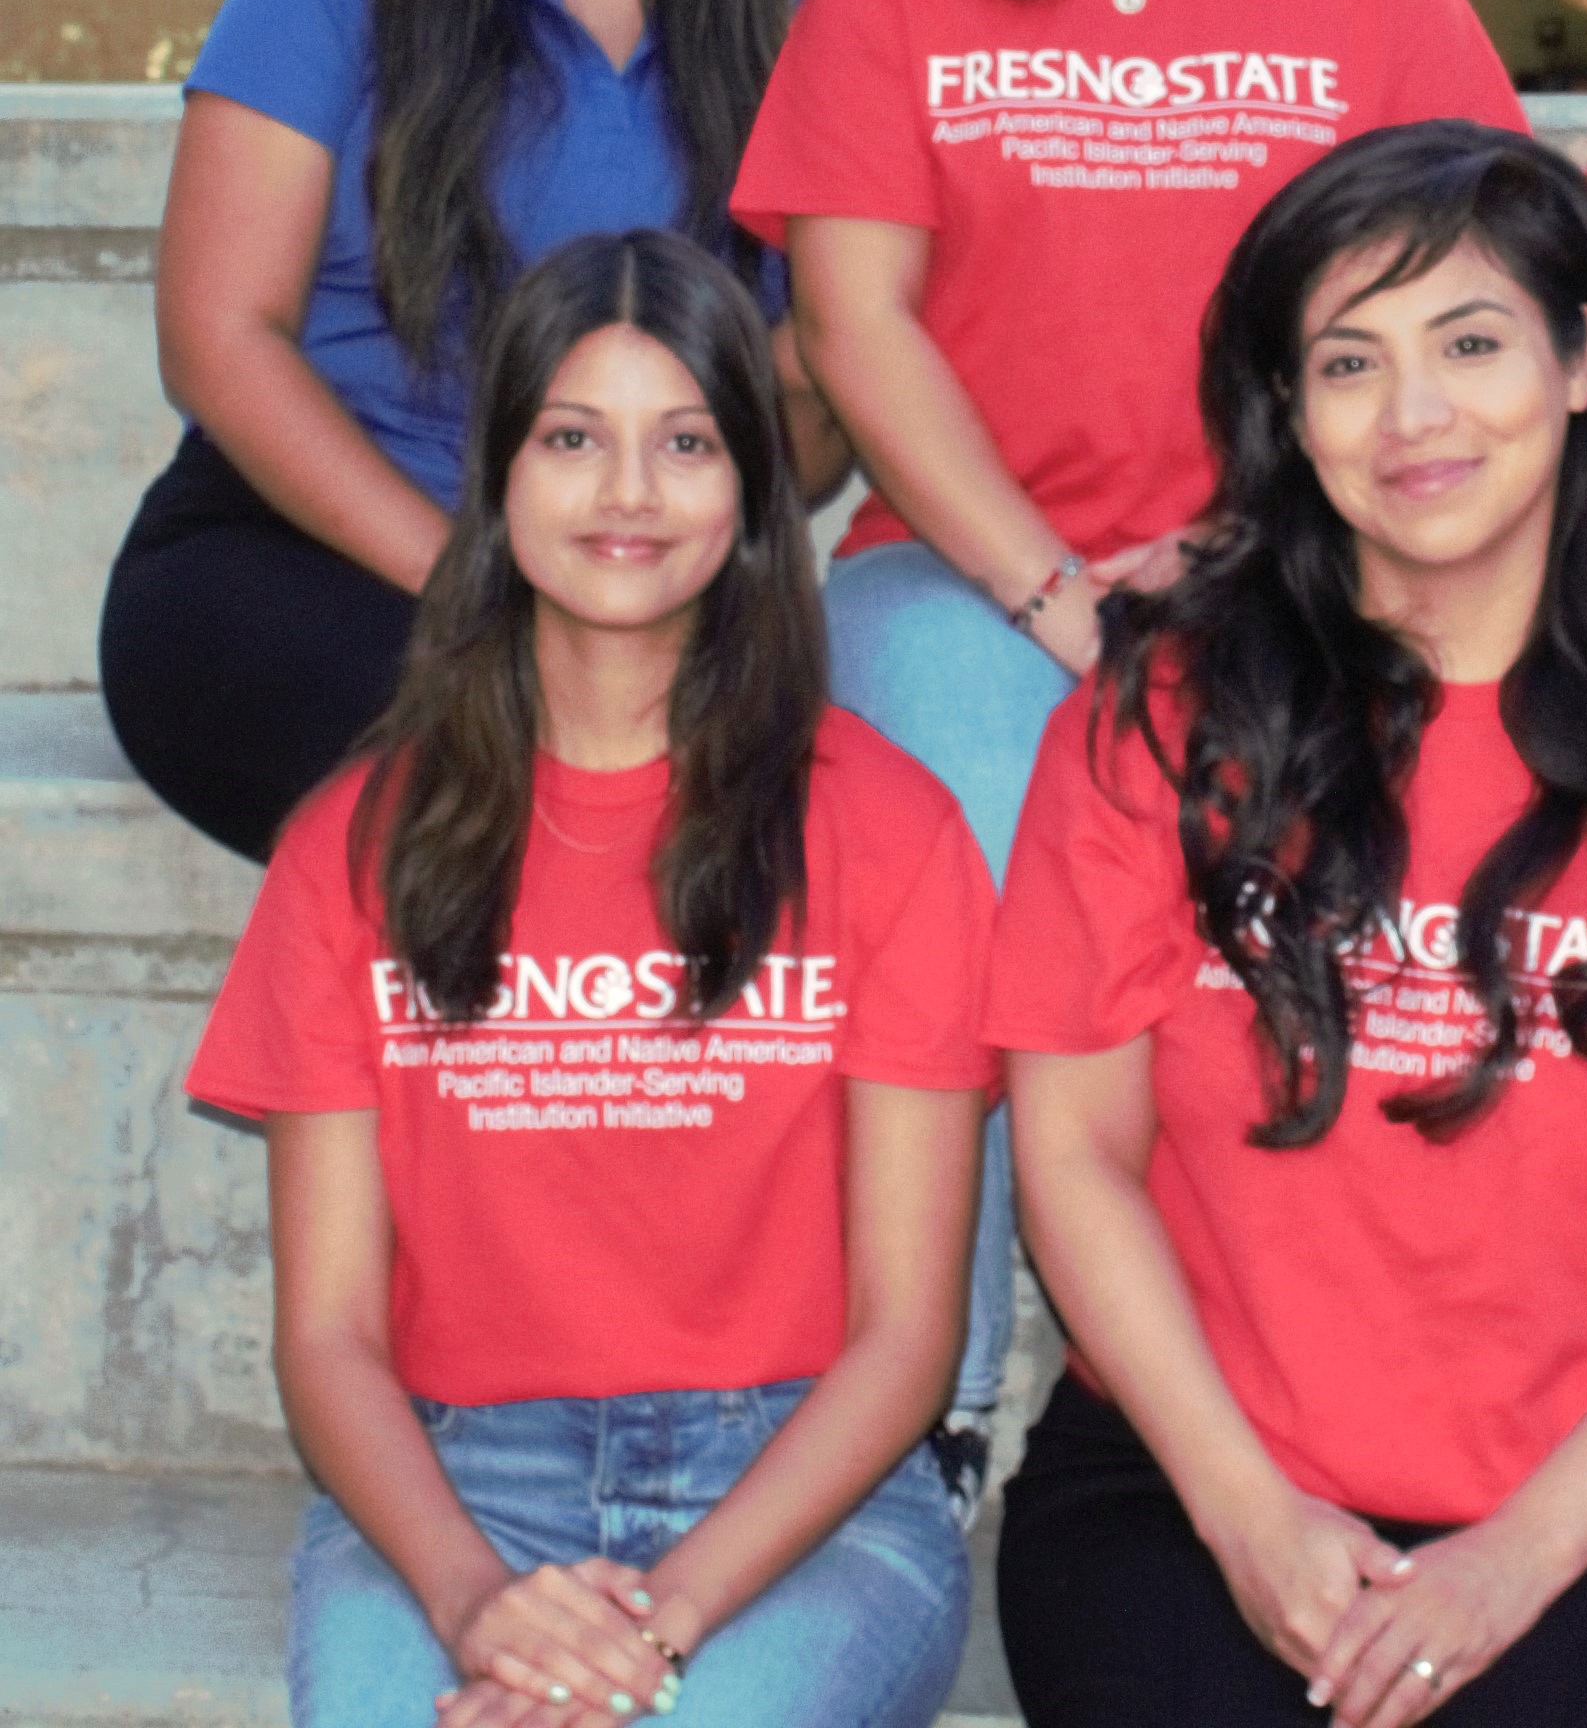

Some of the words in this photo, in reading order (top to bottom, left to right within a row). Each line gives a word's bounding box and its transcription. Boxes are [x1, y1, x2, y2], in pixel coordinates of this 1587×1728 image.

[932, 120, 992, 144] Asian
[993, 111, 1104, 136] American
[1107, 121, 1153, 141] and
[1156, 116, 1230, 140] Native
[1231, 111, 1337, 146] American
[1002, 136, 1080, 161] Pacific
[1030, 161, 1142, 190] Institution
[1144, 165, 1240, 190] Initiative
[1396, 986, 1450, 1015] and
[430, 1037, 554, 1065] American
[559, 1036, 613, 1064] and
[617, 1035, 701, 1063] Native
[704, 1034, 833, 1065] American
[438, 1069, 526, 1099] Pacific
[468, 1102, 598, 1131] Institution
[602, 1101, 713, 1129] Initiative
